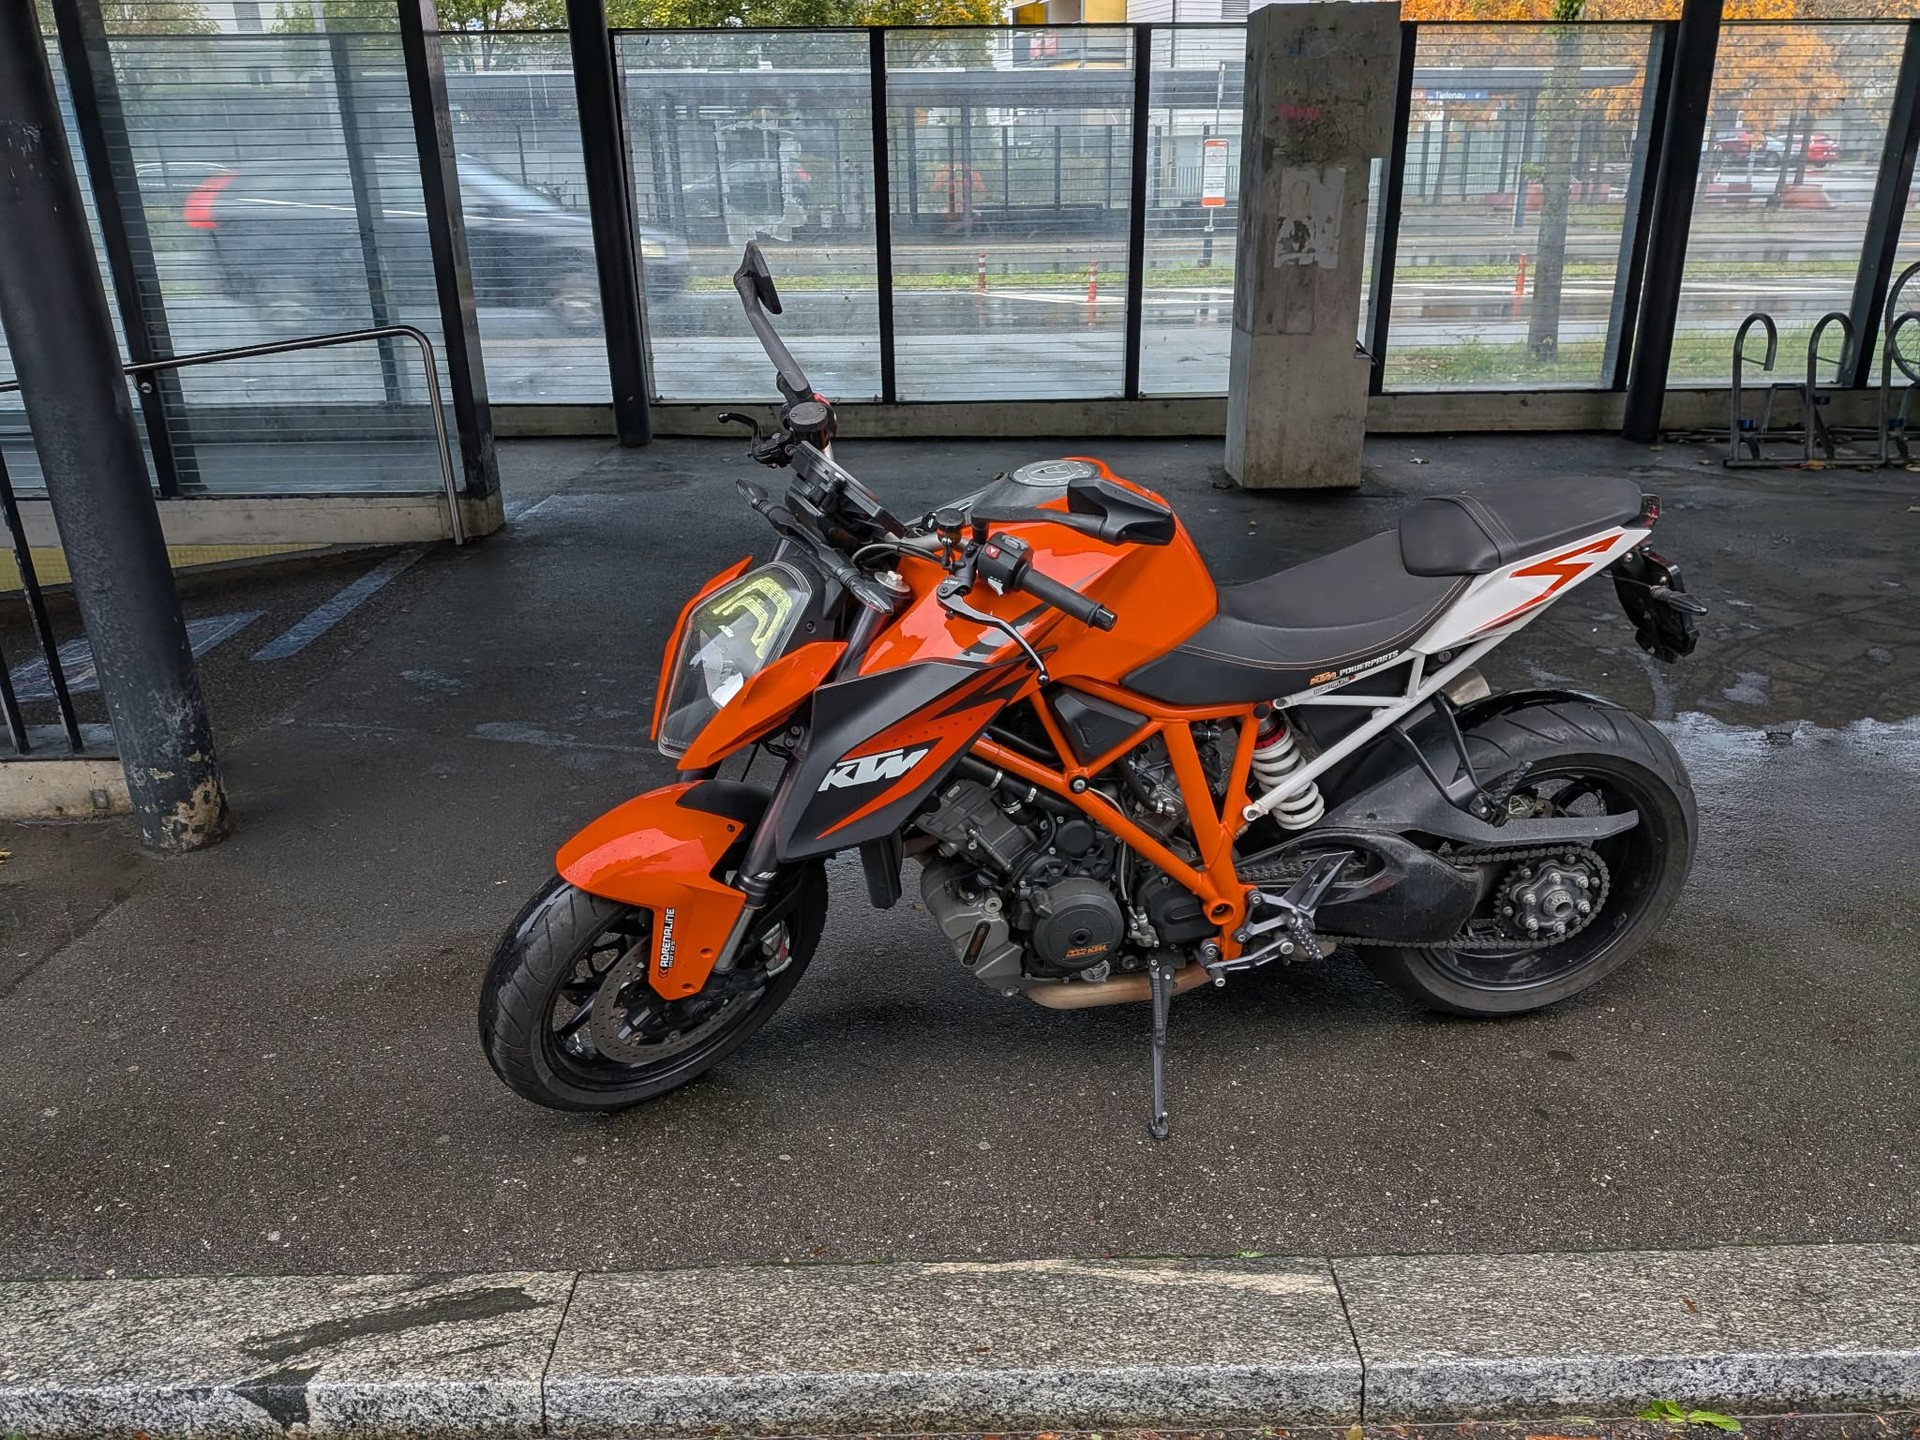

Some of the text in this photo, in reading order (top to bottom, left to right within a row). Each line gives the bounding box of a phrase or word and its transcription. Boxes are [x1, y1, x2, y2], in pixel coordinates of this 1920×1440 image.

[1435, 91, 1466, 99] Tiefenau
[1309, 650, 1399, 685] KTM POWERPARTS
[817, 748, 929, 792] KTM
[660, 908, 675, 968] ADRENALINE
